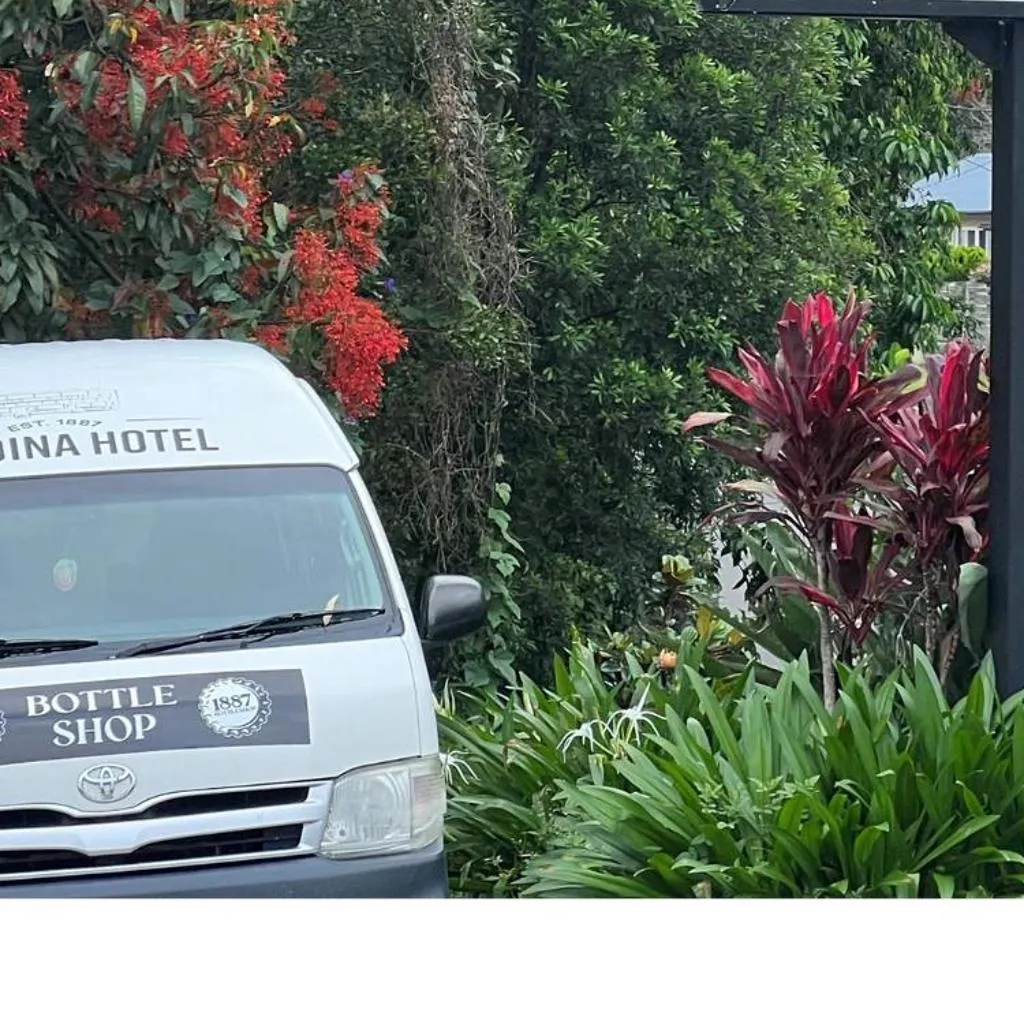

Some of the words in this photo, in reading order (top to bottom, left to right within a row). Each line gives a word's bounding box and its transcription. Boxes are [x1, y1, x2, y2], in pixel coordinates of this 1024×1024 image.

[91, 428, 220, 455] HOTEL
[25, 684, 178, 717] BOTTLE
[213, 693, 251, 711] 1887
[52, 713, 157, 747] SHOP
